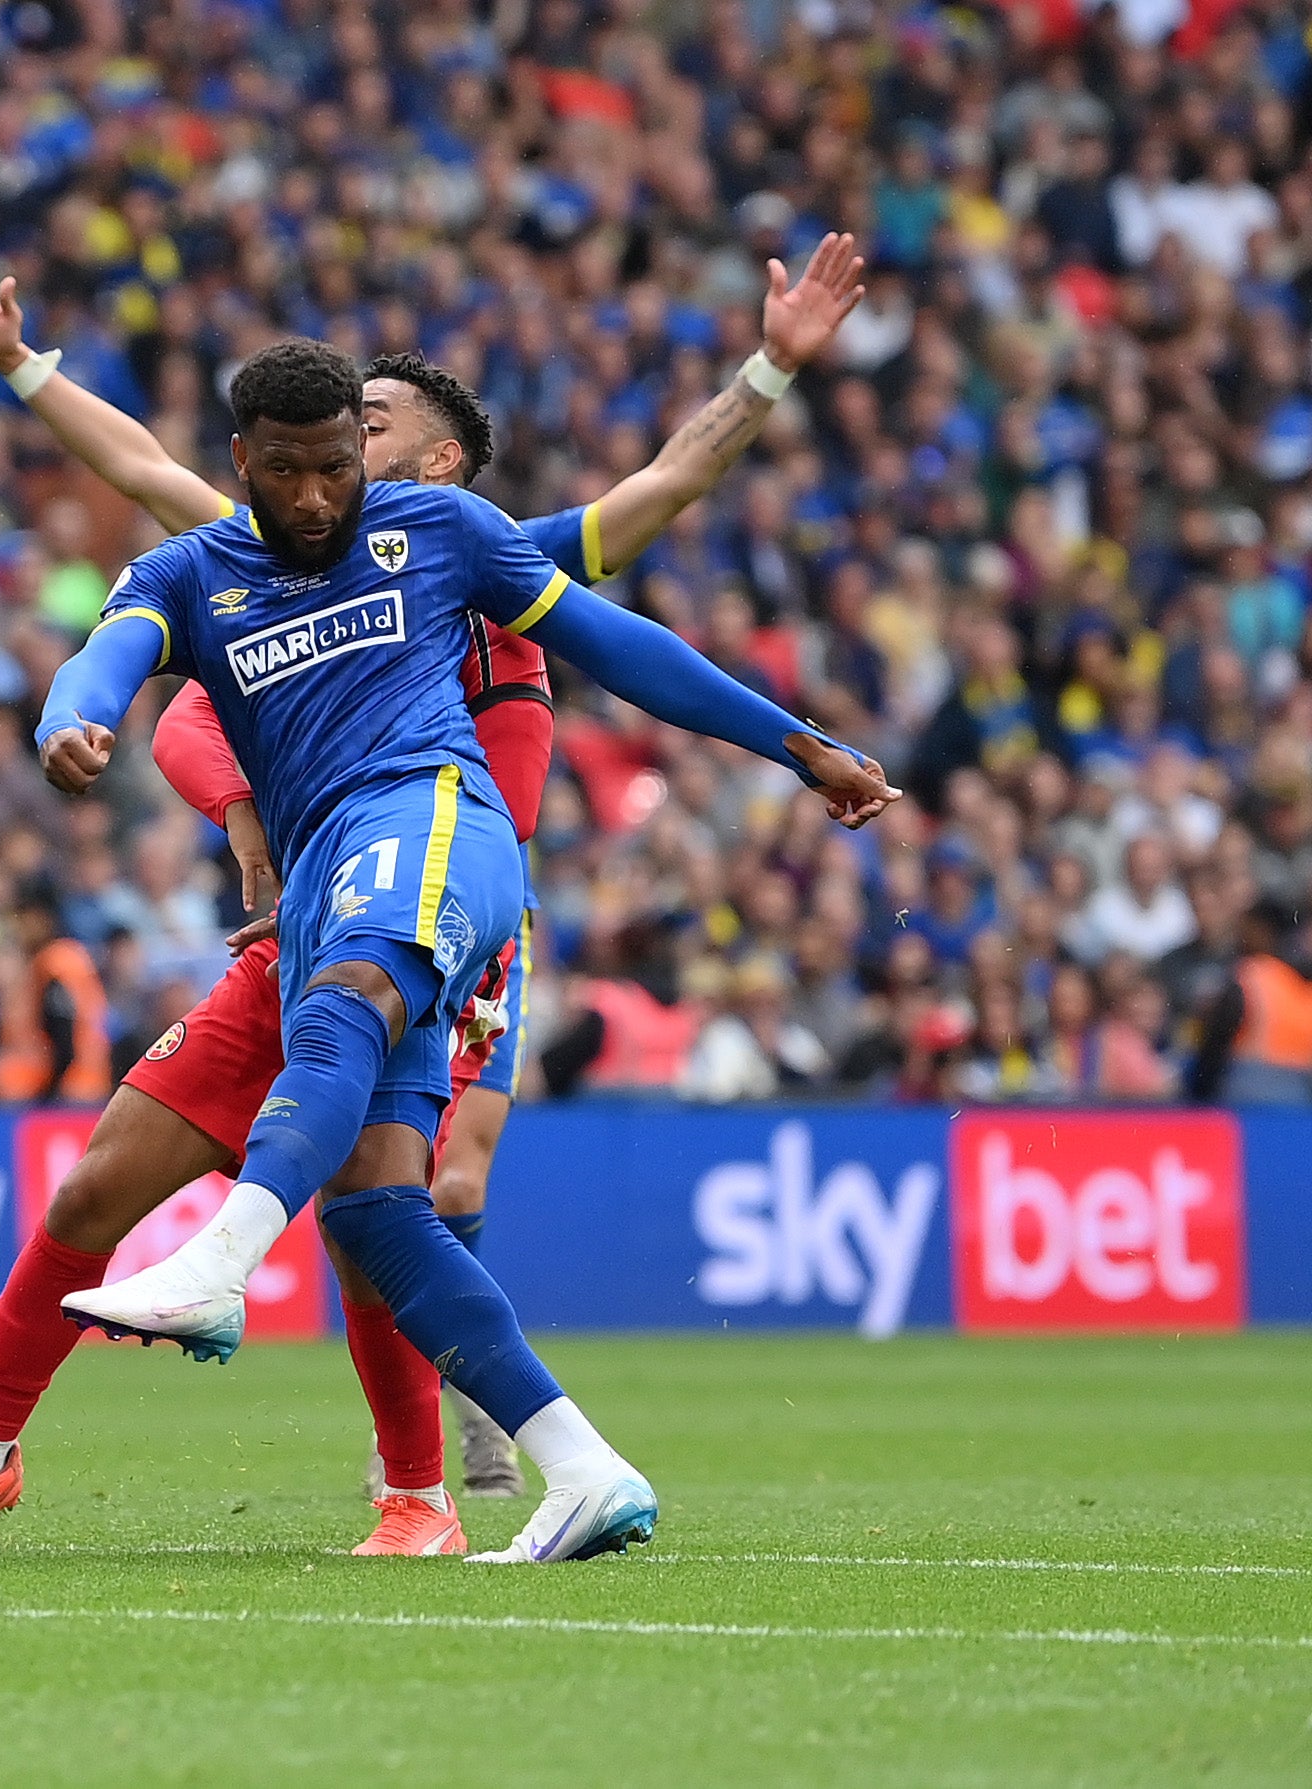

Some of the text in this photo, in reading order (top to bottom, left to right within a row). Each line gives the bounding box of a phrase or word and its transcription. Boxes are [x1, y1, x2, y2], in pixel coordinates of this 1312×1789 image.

[213, 604, 247, 616] umbro
[235, 604, 393, 679] WAR child
[330, 837, 400, 910] 21
[694, 1120, 1218, 1338] sky bet
